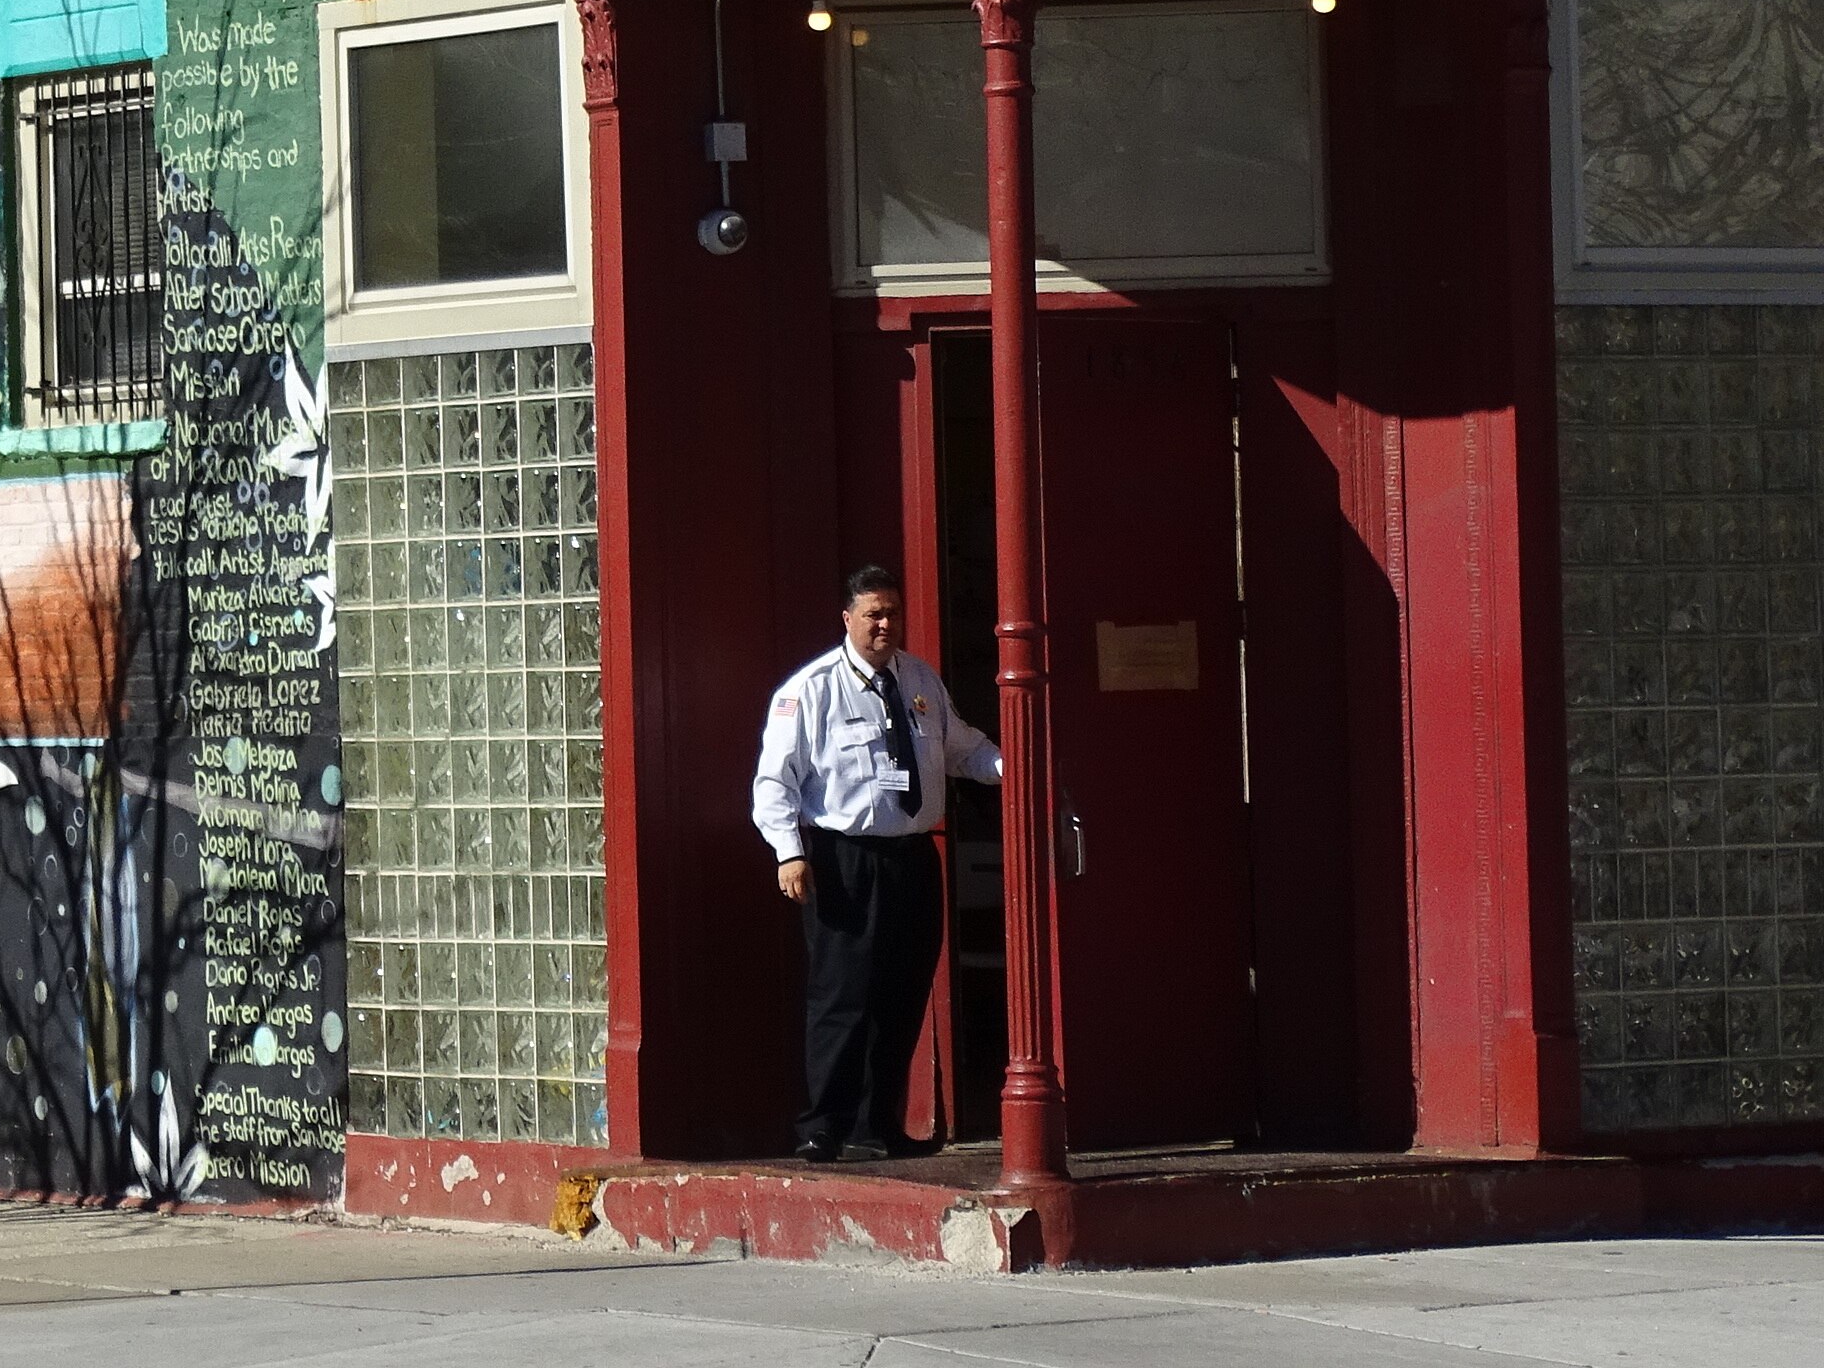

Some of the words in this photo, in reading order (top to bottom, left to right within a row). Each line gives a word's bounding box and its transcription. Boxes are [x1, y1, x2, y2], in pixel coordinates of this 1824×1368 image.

[177, 13, 222, 56] Was
[227, 9, 277, 51] made
[162, 60, 233, 103] possibe
[240, 56, 260, 98] by
[264, 55, 299, 91] the
[161, 102, 245, 146] following
[267, 138, 299, 168] and
[163, 178, 215, 215] Artists
[236, 226, 270, 267] Arts
[270, 216, 323, 259] Reach
[164, 270, 206, 312] After
[211, 274, 265, 314] School
[239, 310, 307, 356] Obrero
[170, 360, 241, 402] Mission
[175, 409, 248, 449] National
[253, 406, 326, 447] Muse
[150, 449, 172, 482] of
[175, 448, 253, 484] Mexican
[150, 492, 185, 519] Lead
[220, 547, 265, 575] Artist
[188, 585, 244, 613] Maritza
[249, 582, 311, 608] Alvarez
[189, 614, 244, 642] Gabriel
[268, 641, 320, 674] Duran
[190, 679, 262, 710] Gabriela
[195, 770, 246, 799] Delmis
[251, 771, 301, 803] Molina
[268, 801, 321, 832] Molina
[199, 830, 251, 863] Joseph
[255, 832, 295, 865] Mora
[284, 862, 329, 899] Mora
[203, 897, 251, 927] Daniel
[259, 898, 303, 932] Rojas
[206, 926, 256, 956] Rafael
[260, 929, 304, 966] Rojas
[206, 959, 247, 987] Dario
[251, 957, 297, 994] Rojas
[207, 991, 260, 1026] Andrea
[262, 995, 313, 1039] Vargas
[208, 1030, 270, 1065] Emilia
[195, 1084, 248, 1116] Special
[246, 1086, 300, 1122] Thanks
[302, 1098, 318, 1123] to
[320, 1096, 341, 1127] all
[223, 1116, 255, 1143] staff
[256, 1117, 291, 1147] from
[291, 1122, 316, 1148] San
[250, 1150, 311, 1189] Mission
